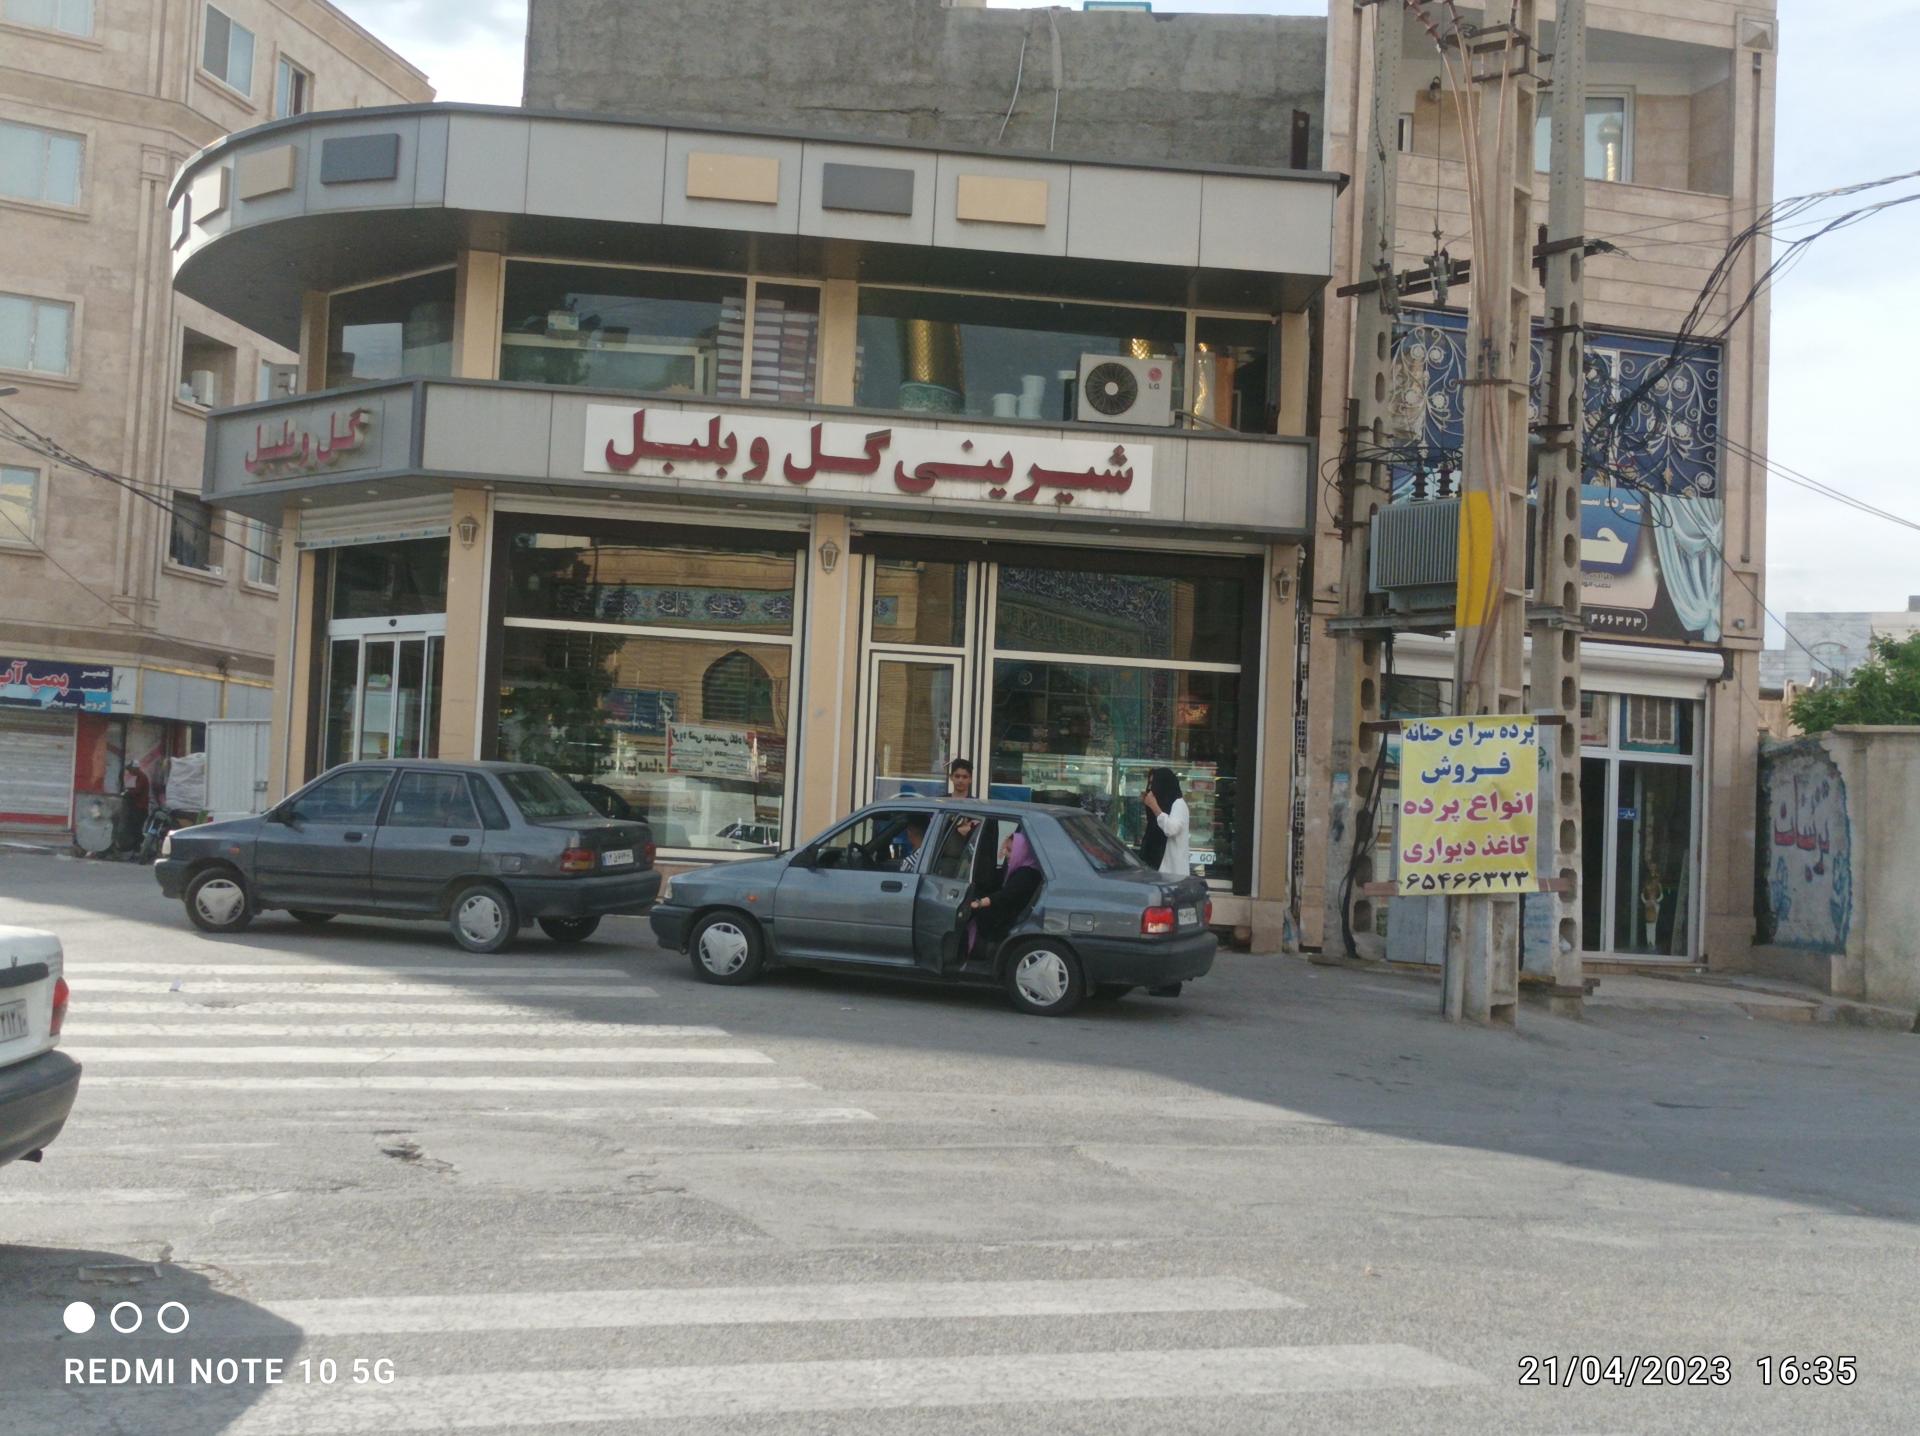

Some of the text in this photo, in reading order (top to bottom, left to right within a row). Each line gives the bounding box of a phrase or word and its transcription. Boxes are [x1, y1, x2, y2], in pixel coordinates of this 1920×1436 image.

[1148, 382, 1160, 390] LG
[317, 407, 369, 464] گل
[605, 409, 1134, 502] شیرینی گل و بلبل
[26, 673, 69, 696] پمپ
[1405, 723, 1444, 742] حنانه
[1499, 723, 1535, 745] پرده
[1421, 752, 1511, 784] فروش
[1403, 791, 1533, 822] انواع پرده
[1403, 834, 1529, 864] کاغذ دیواری
[1406, 871, 1529, 890] ۶۵۴۶۶۳۲۳
